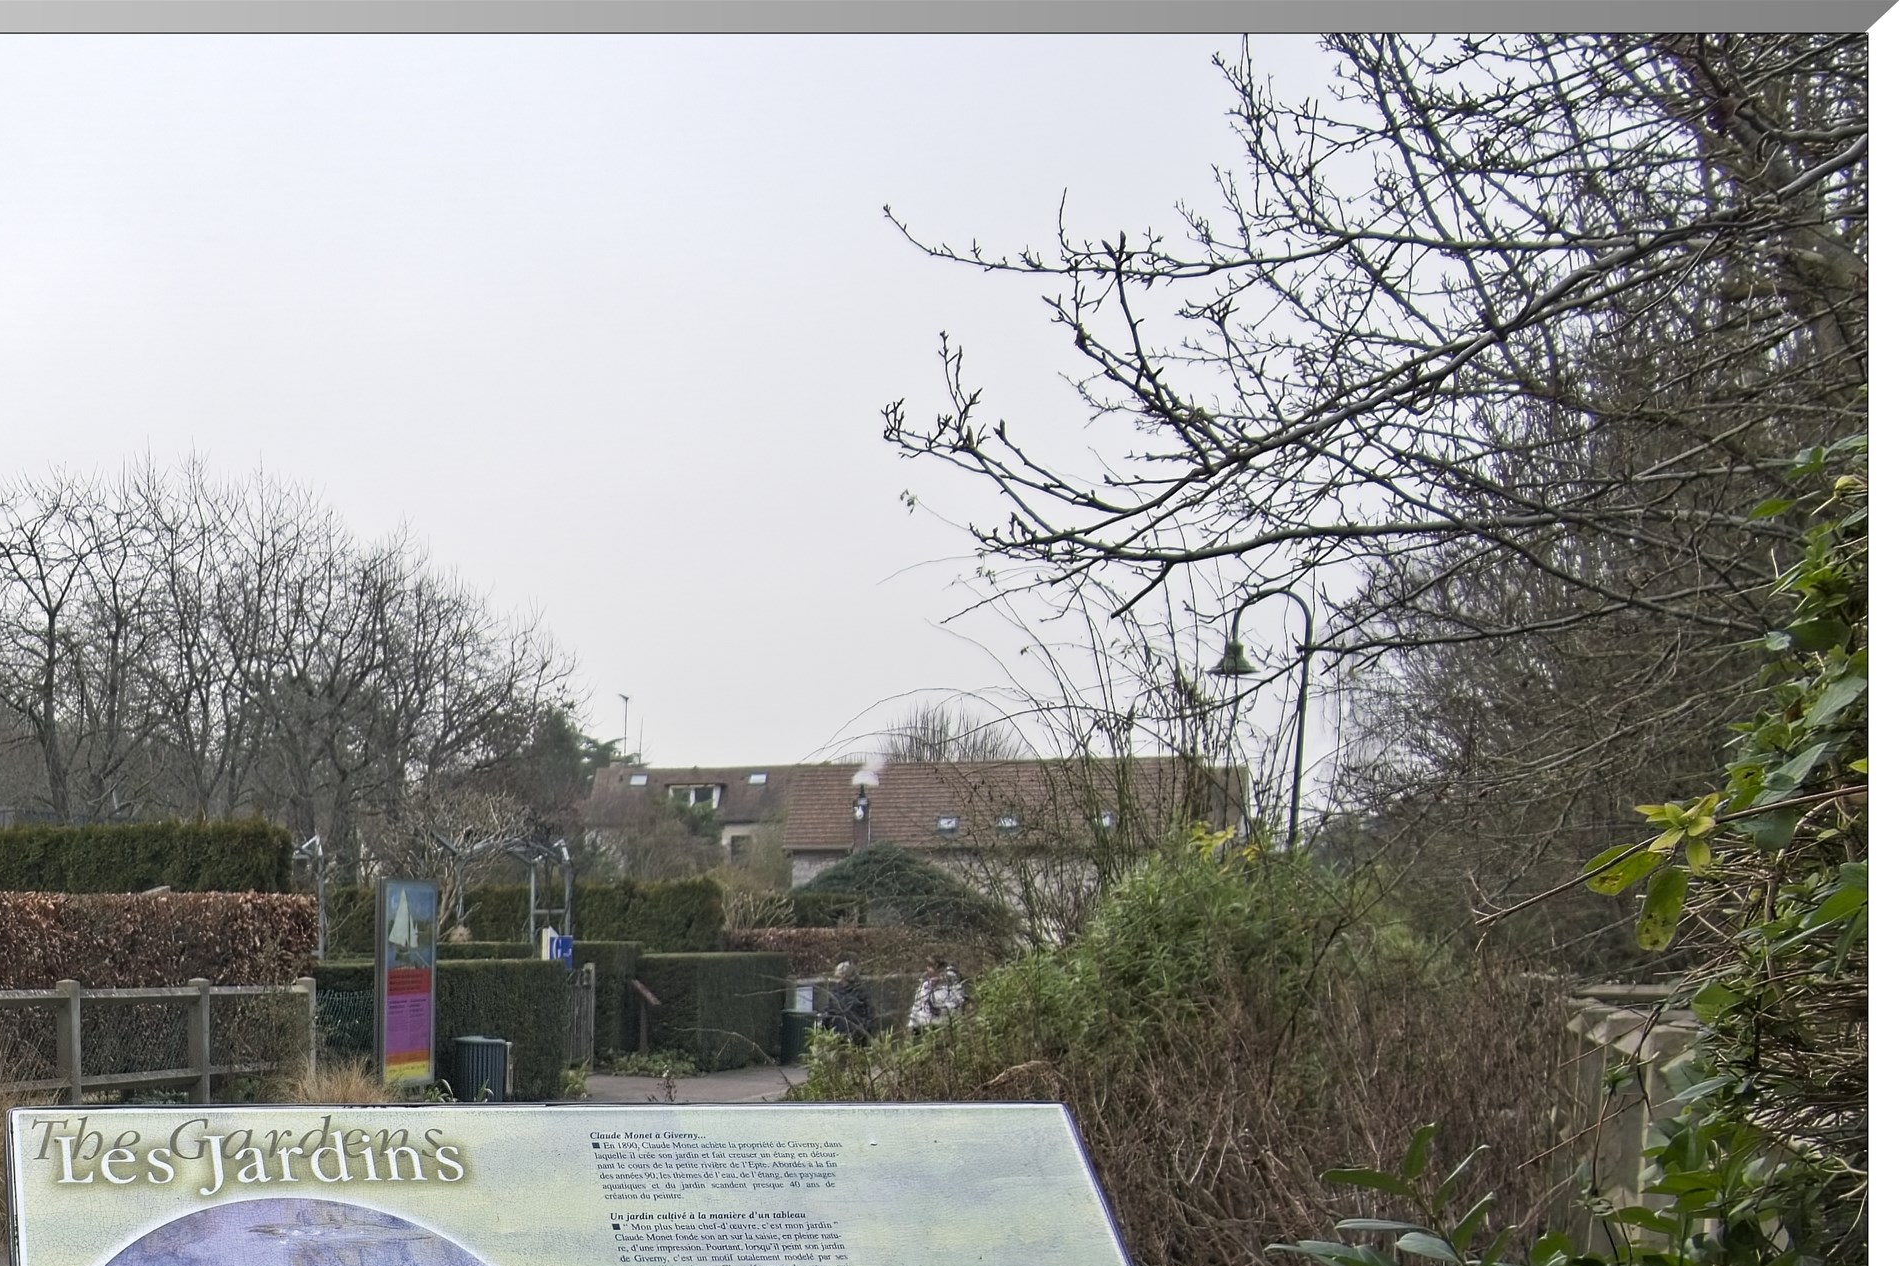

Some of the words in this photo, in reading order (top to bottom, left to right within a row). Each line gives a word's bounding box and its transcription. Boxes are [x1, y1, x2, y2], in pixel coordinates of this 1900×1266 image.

[32, 1117, 141, 1161] The
[169, 1115, 444, 1161] Gardens
[737, 1141, 774, 1150] propriété
[55, 1135, 175, 1184] Les
[200, 1132, 465, 1196] Jardins
[626, 1212, 653, 1221] jardin
